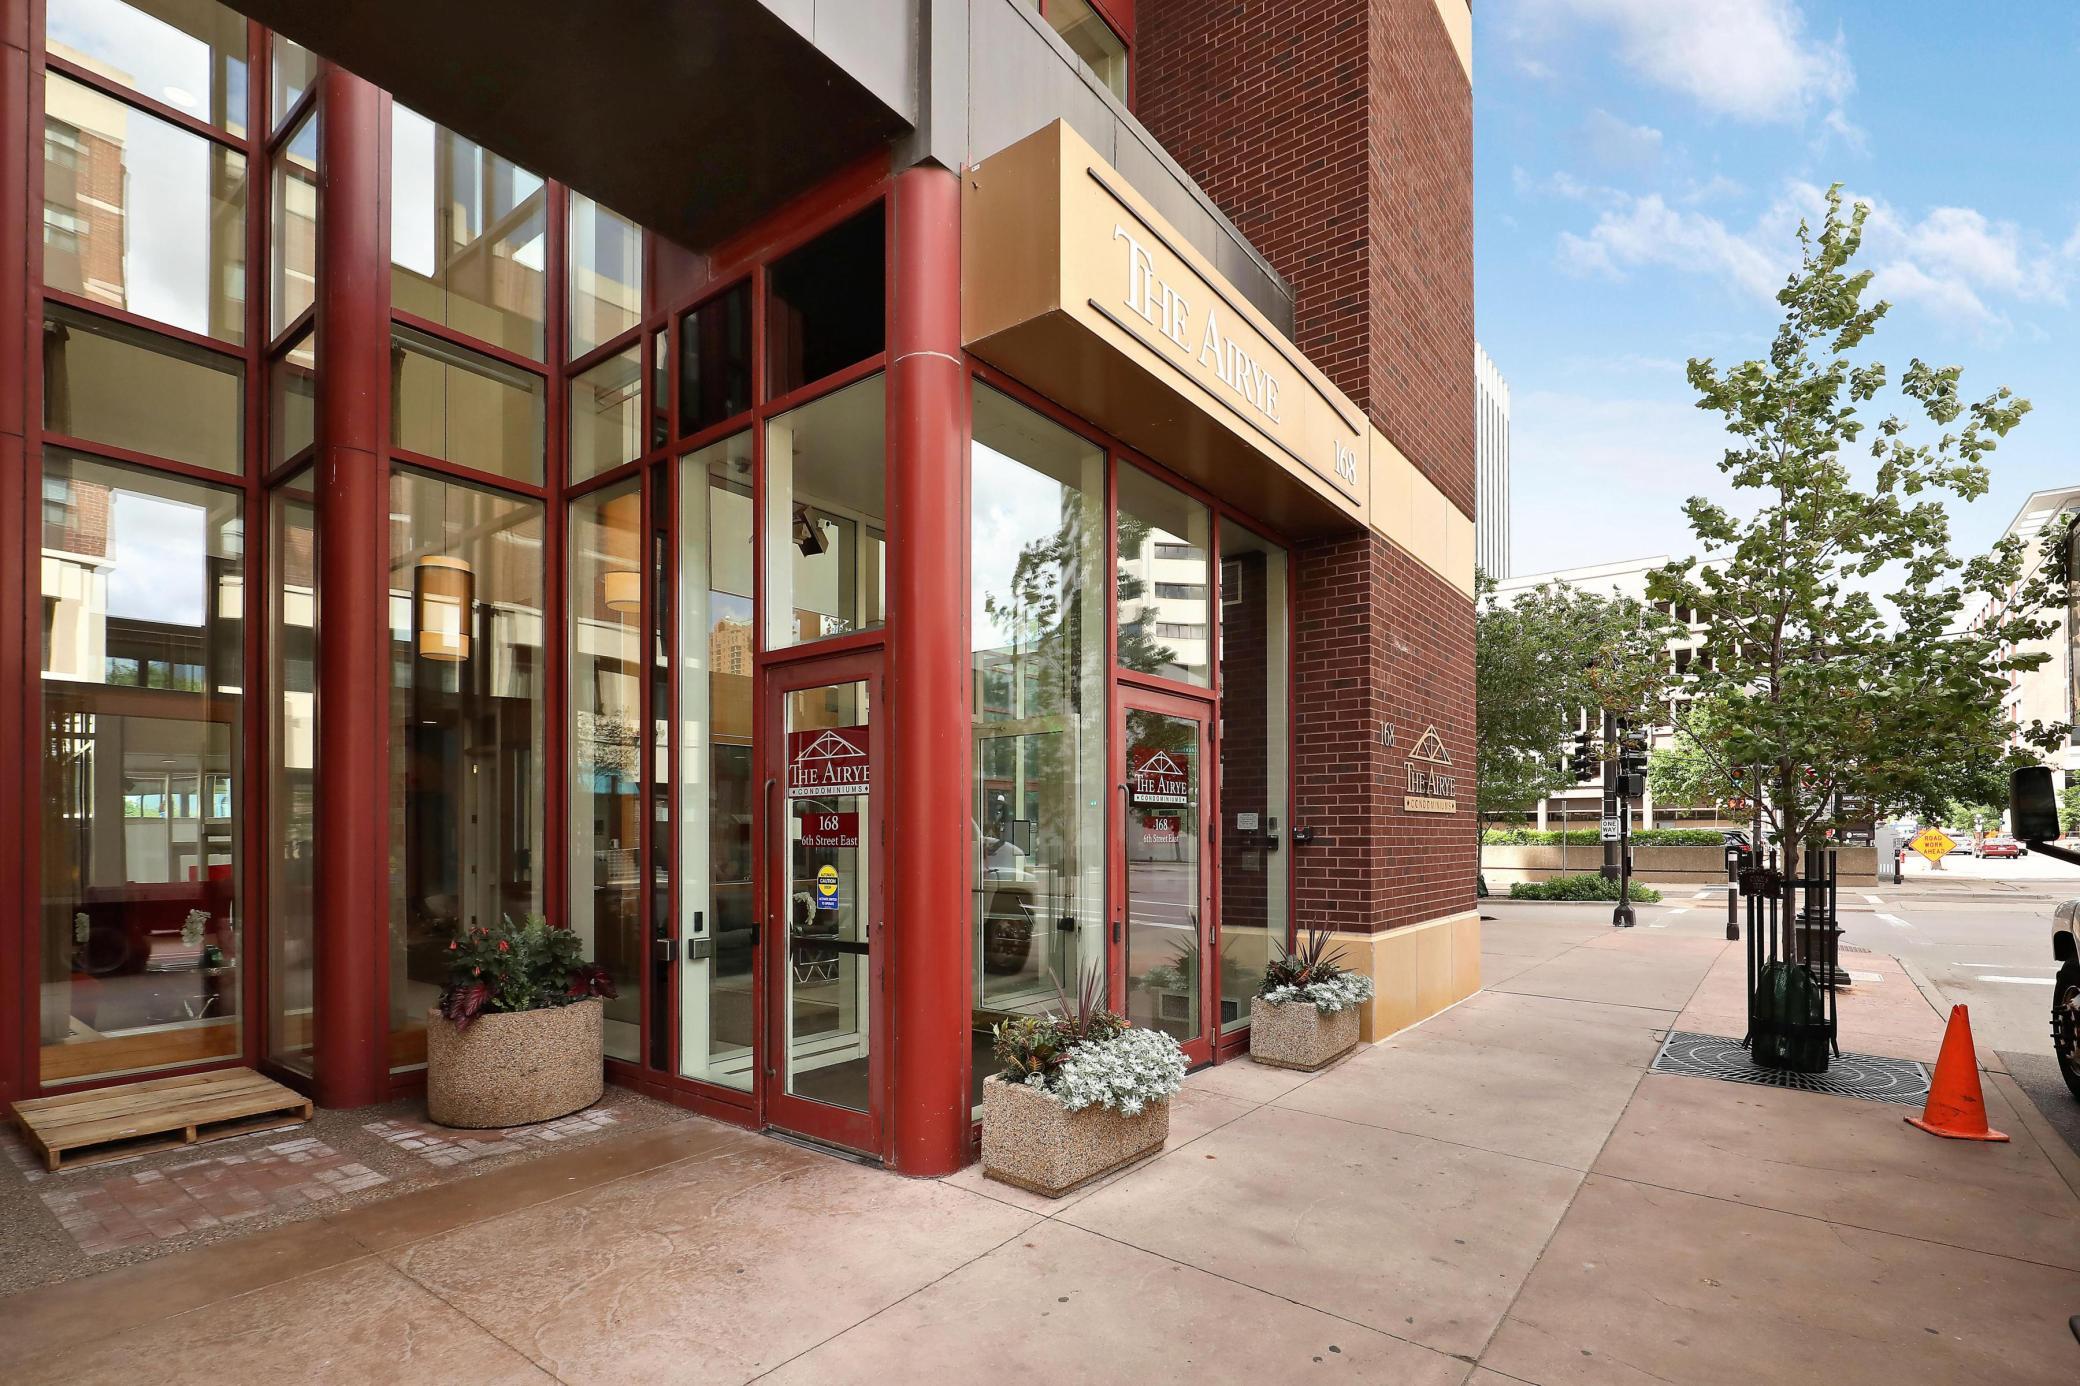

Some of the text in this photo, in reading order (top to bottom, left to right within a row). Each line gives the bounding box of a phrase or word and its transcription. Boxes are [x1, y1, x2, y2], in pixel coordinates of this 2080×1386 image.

[1112, 223, 1281, 425] THE AIRYE
[1333, 438, 1357, 486] 168
[1380, 720, 1395, 747] 168
[789, 760, 869, 785] THE AIRYE
[1403, 761, 1456, 797] THE AIRYE
[797, 785, 863, 796] CONDOMINIUMS
[1135, 774, 1187, 795] THE AIRYE
[819, 815, 839, 831] 168
[1155, 818, 1168, 831] 168
[801, 834, 858, 846] 6th Street East
[1153, 833, 1168, 843] Street
